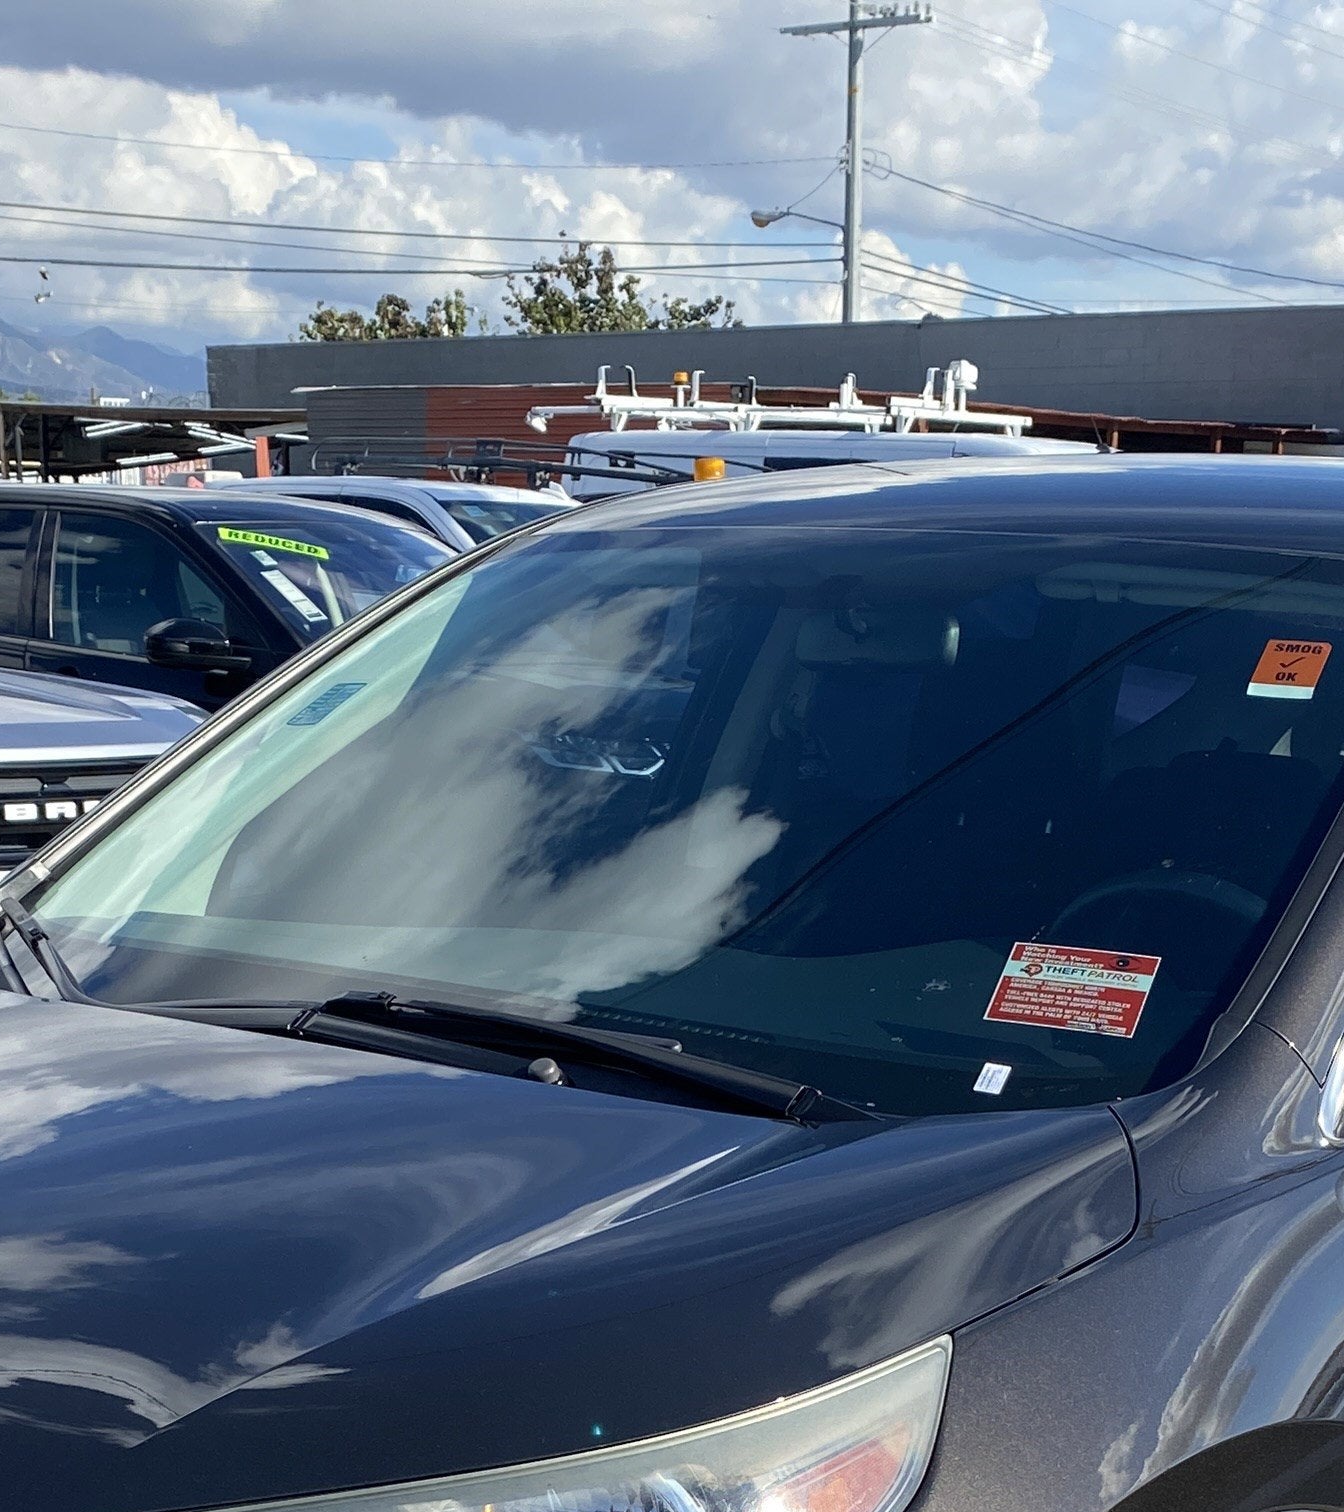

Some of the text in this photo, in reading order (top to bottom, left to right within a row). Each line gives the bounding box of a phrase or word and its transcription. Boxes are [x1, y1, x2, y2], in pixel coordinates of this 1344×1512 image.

[227, 529, 322, 554] REDUCED
[1274, 642, 1324, 655] SMOG
[1274, 671, 1298, 682] OK
[1044, 965, 1087, 978] THEFT
[1087, 970, 1139, 984] PATROL
